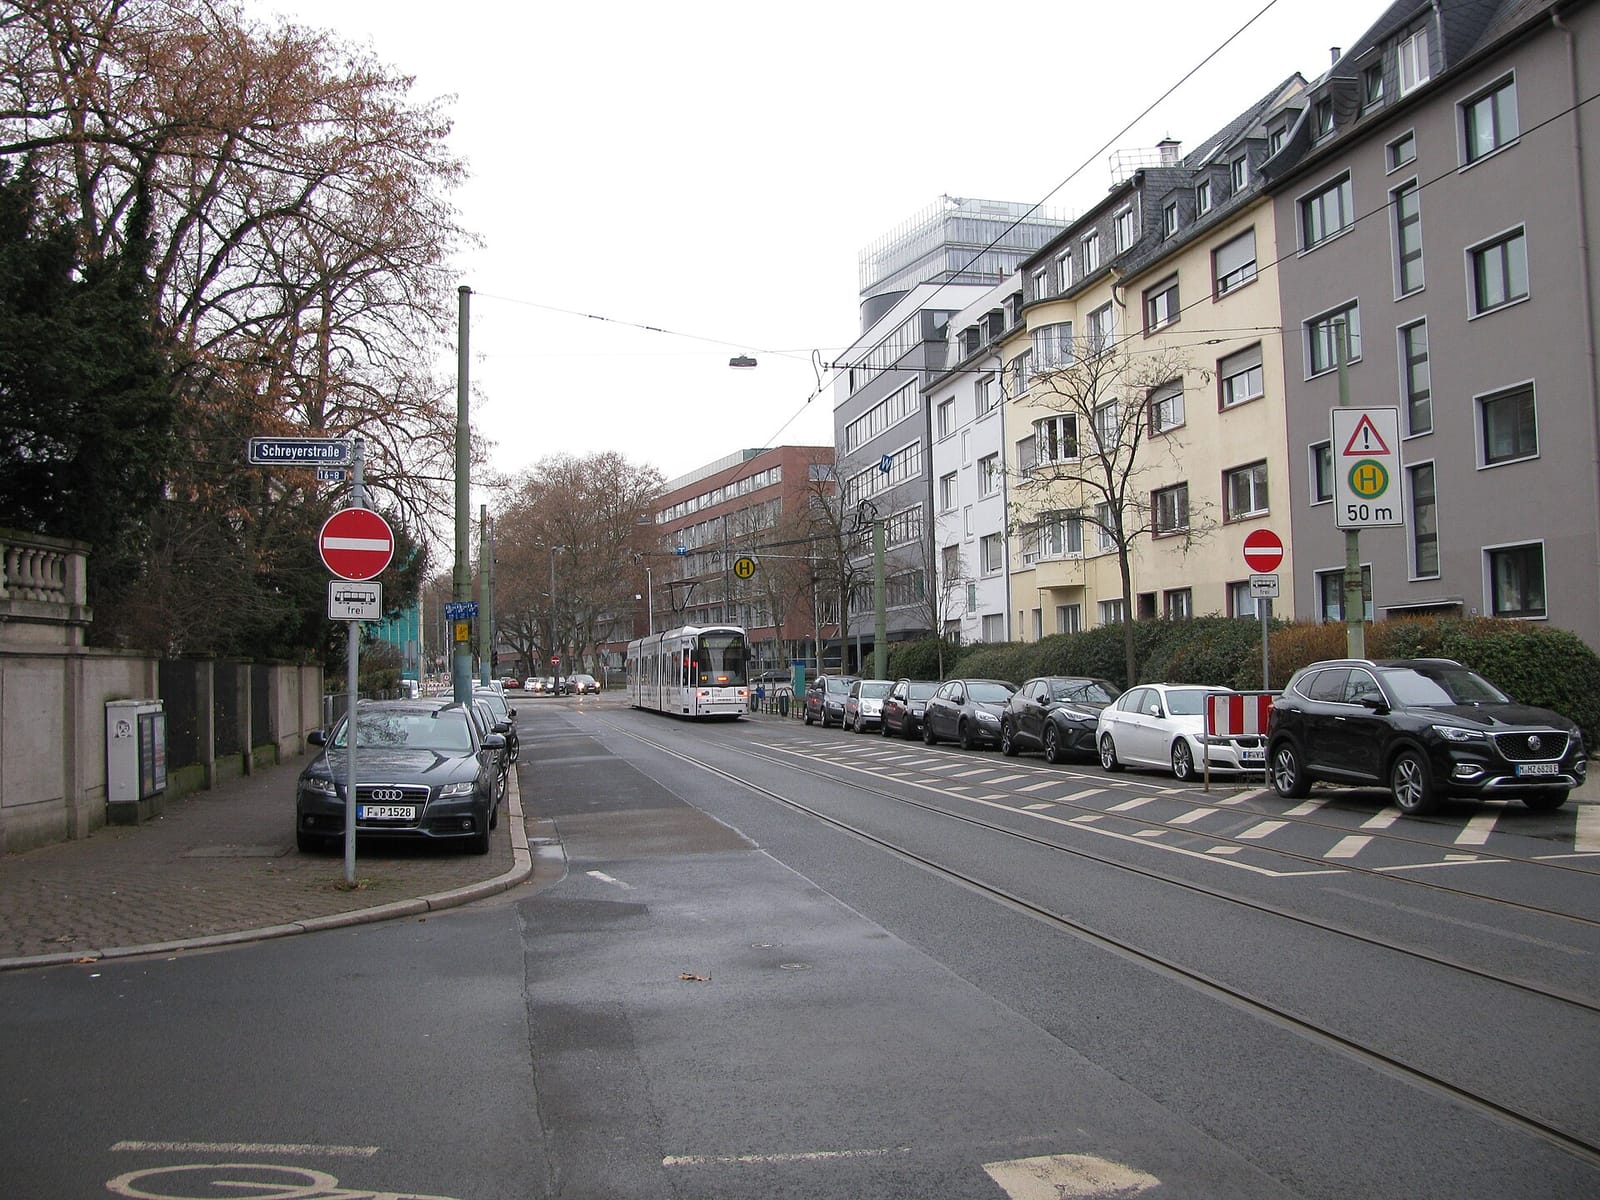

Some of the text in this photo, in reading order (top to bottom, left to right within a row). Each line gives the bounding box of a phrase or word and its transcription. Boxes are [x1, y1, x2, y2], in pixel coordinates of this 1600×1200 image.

[262, 444, 340, 460] Schreyerstraße
[1360, 468, 1377, 490] H
[1347, 504, 1392, 521] 50 m
[740, 561, 750, 575] H
[347, 605, 364, 614] frei
